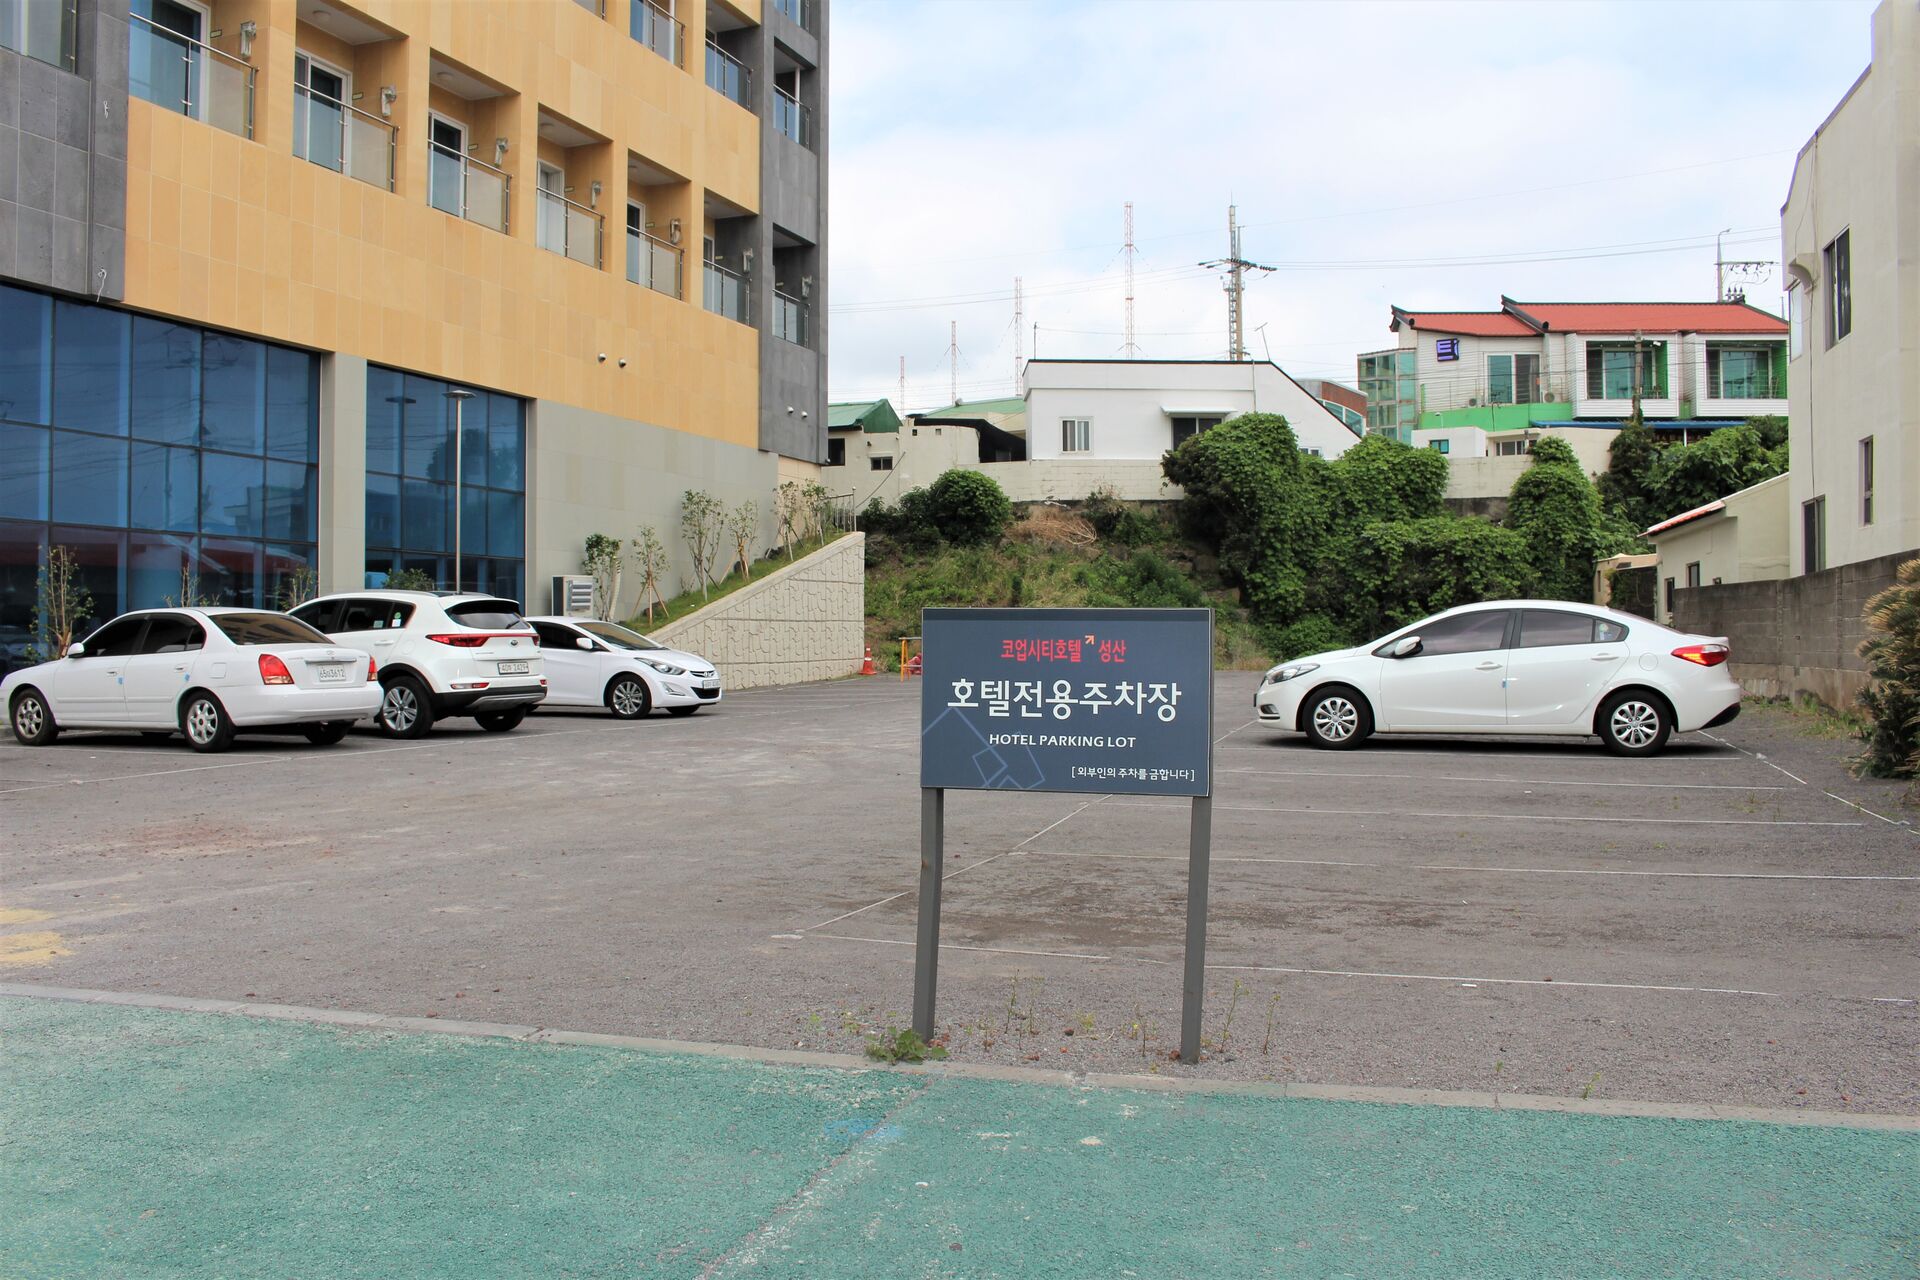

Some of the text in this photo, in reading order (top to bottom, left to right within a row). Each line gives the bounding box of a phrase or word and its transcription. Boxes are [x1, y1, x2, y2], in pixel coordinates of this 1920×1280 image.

[1000, 638, 1127, 663] 코업시티호텔 성산
[947, 678, 1182, 722] 호텔전용주차장
[989, 733, 1137, 748] HOTEL PARKING LOT
[1118, 768, 1148, 780] 주차를
